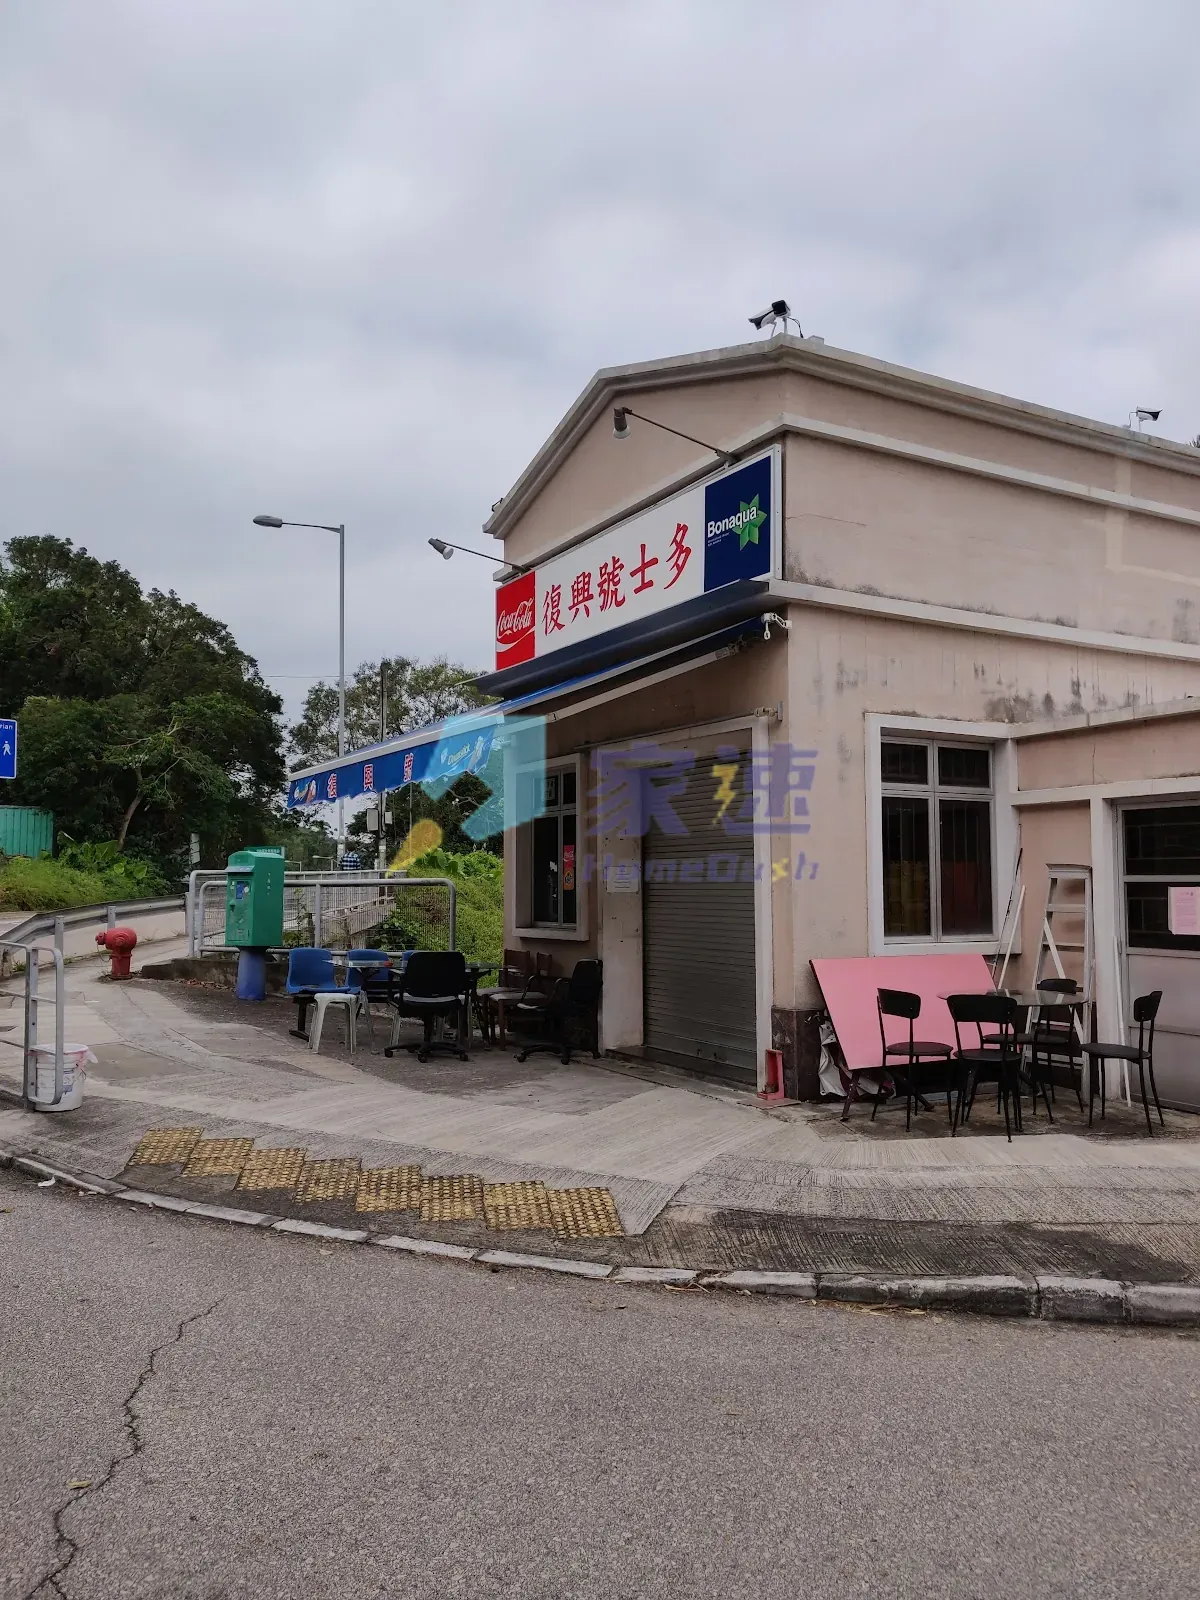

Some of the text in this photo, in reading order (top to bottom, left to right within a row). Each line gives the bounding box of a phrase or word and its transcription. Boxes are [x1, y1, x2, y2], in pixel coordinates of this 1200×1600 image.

[708, 506, 757, 538] Bonaqua
[540, 523, 692, 637] 復興號士多
[497, 597, 534, 639] Coca-Cola
